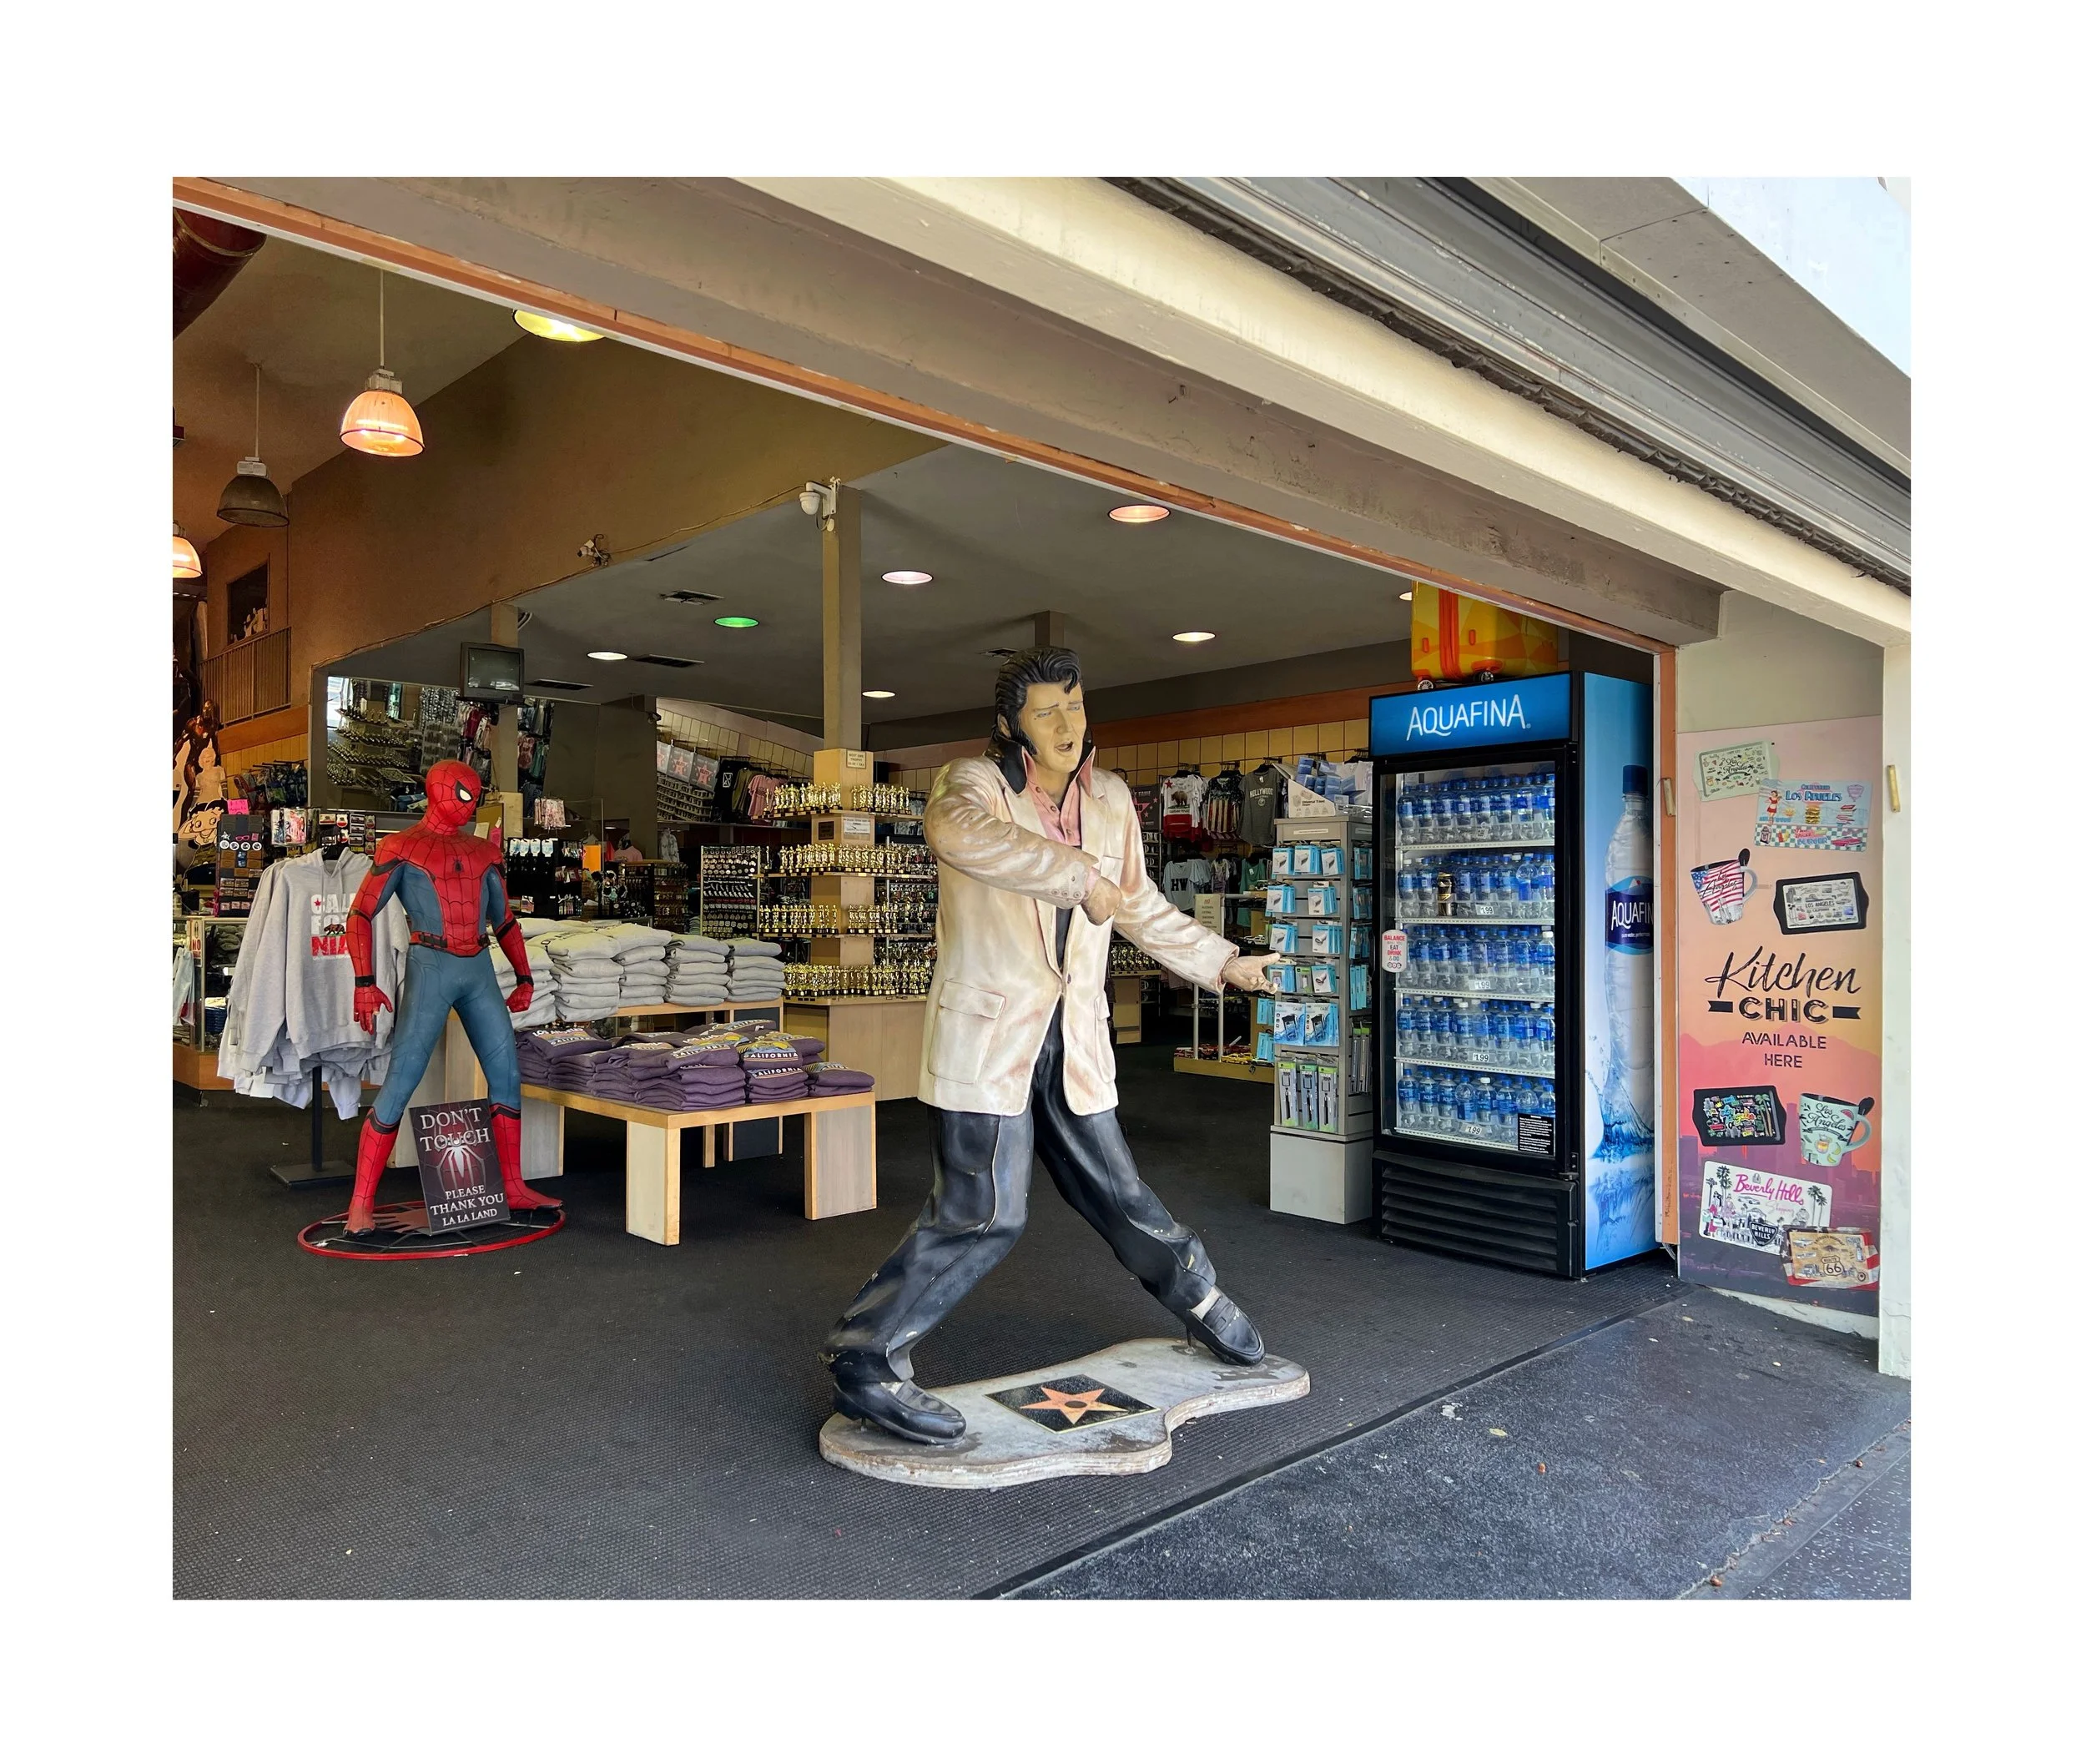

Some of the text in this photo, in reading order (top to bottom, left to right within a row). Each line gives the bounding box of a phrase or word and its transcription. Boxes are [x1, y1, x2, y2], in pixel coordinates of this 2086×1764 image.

[1406, 694, 1527, 741] AQUAFINA
[1249, 788, 1274, 798] HOLLYWOOD
[1705, 945, 1862, 998] Kitchen
[1738, 996, 1829, 1024] CHIC
[1742, 1031, 1827, 1050] AVAILABLE
[1764, 1053, 1803, 1068] HERE
[420, 1107, 481, 1130] DON'T
[1816, 1103, 1833, 1119] Los
[1806, 1112, 1846, 1131] Angeles
[420, 1128, 491, 1152] TOUCH
[446, 1184, 486, 1200] PLEASE
[1733, 1174, 1804, 1206] Beverly Hills
[430, 1193, 504, 1216] THANK YOU
[442, 1208, 497, 1227] LA LA LAND
[1751, 1224, 1776, 1234] BEVERLY
[1755, 1232, 1771, 1240] HILLS
[1827, 1263, 1842, 1274] 66
